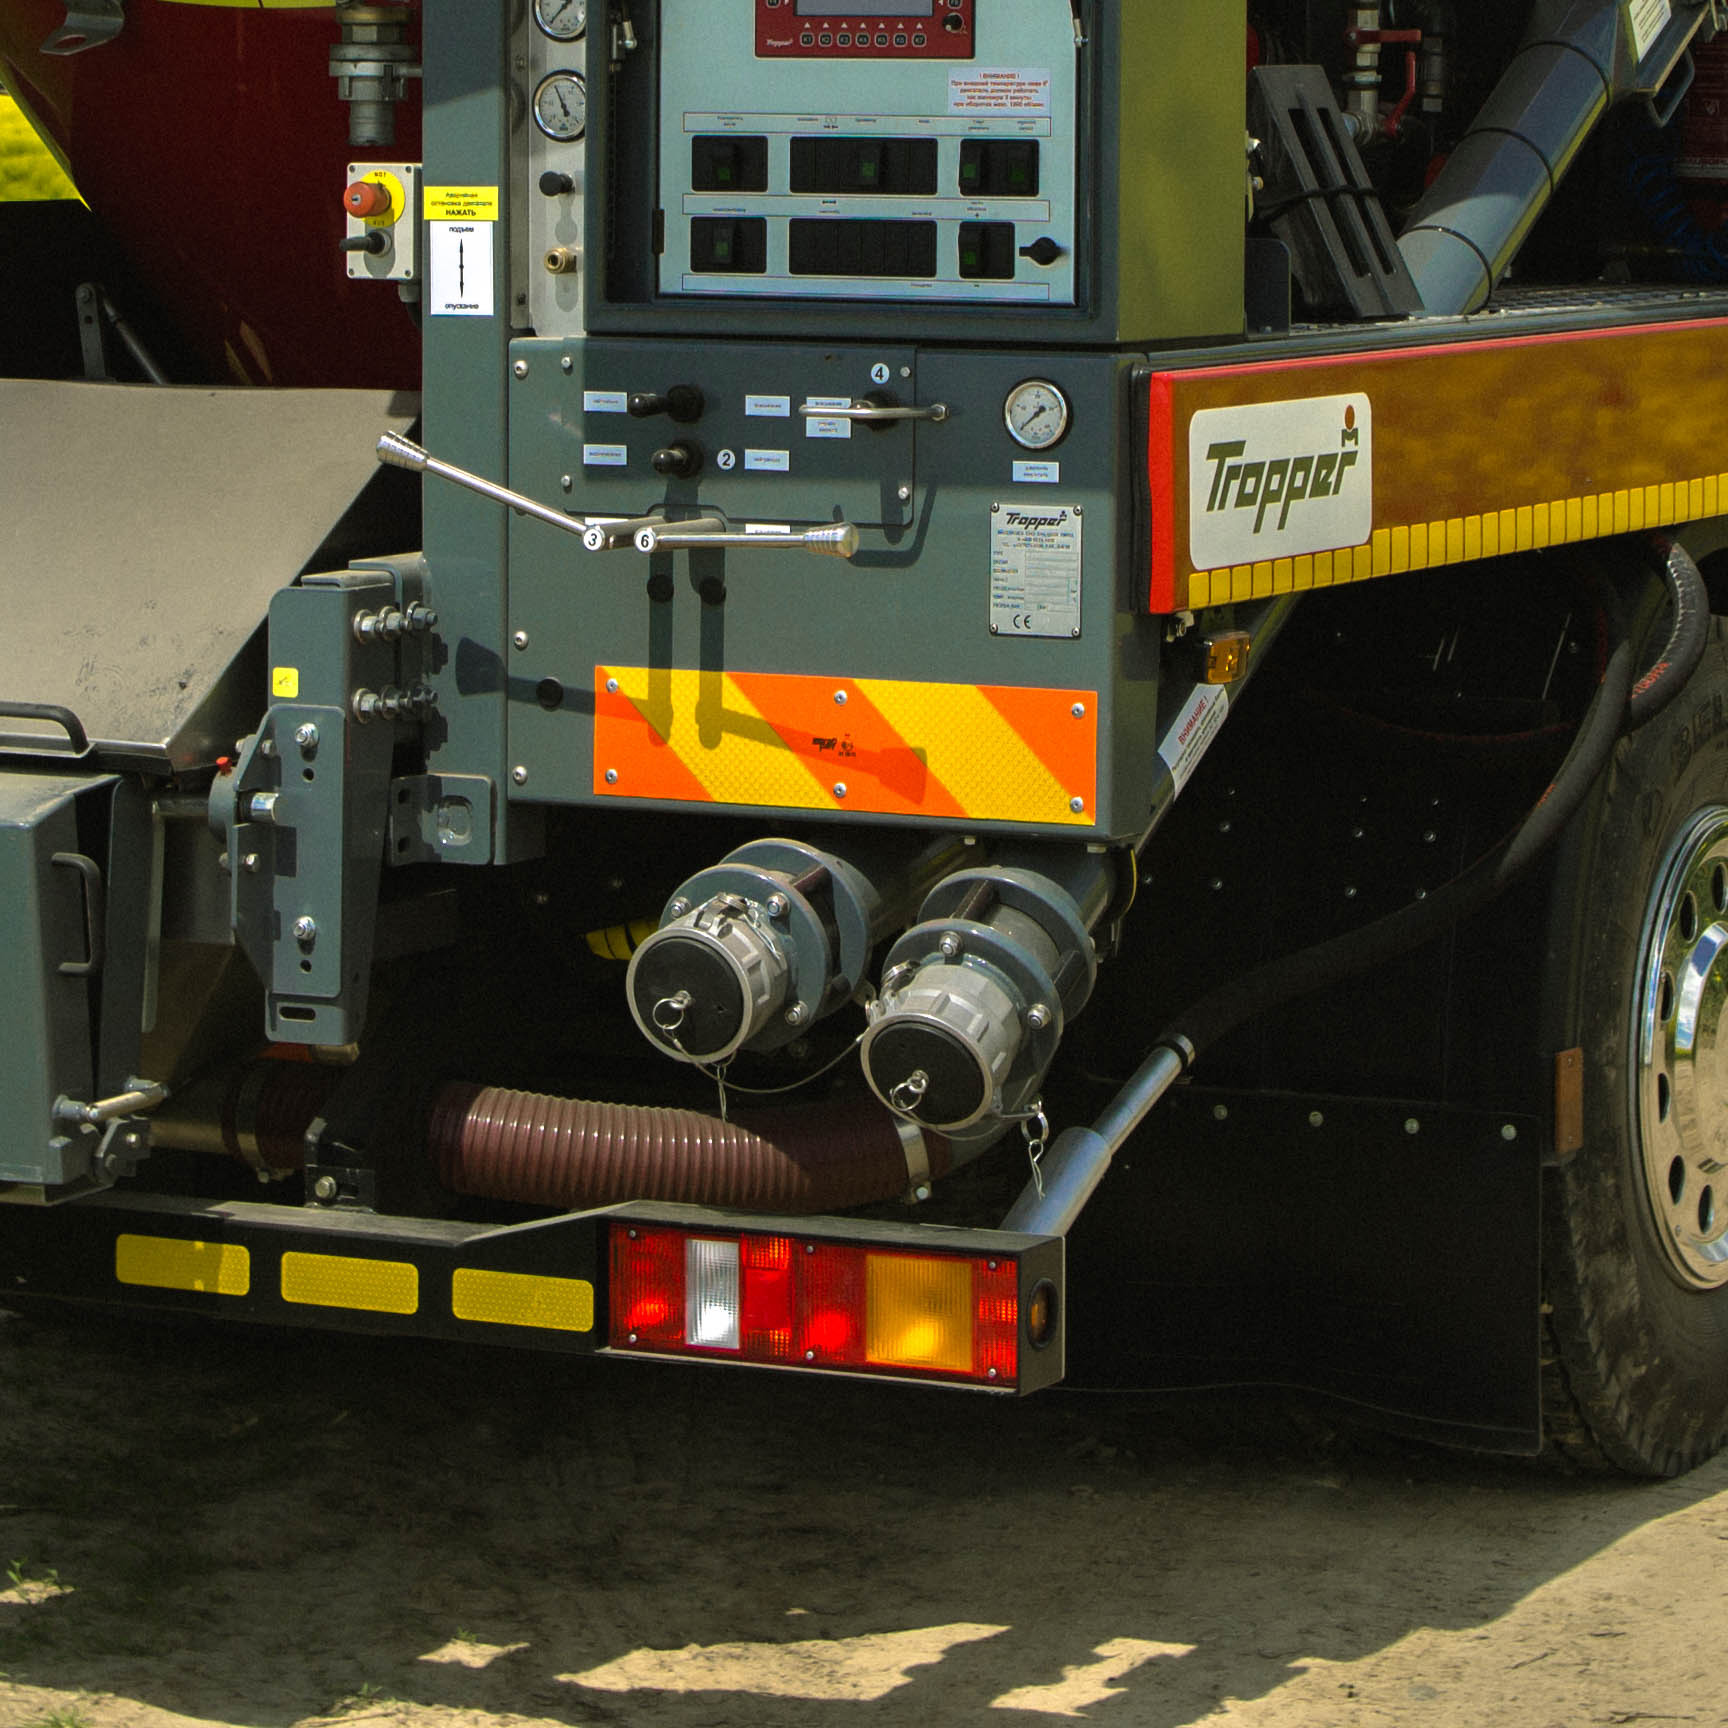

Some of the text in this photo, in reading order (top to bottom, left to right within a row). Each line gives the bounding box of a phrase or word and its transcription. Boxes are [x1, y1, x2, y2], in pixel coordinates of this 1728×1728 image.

[445, 209, 477, 217] НАЖАТЬ
[874, 367, 883, 380] 4
[722, 452, 731, 467] 2
[1206, 440, 1358, 535] Tropper
[1006, 512, 1067, 530] Tropper
[587, 533, 597, 547] 3
[640, 534, 649, 548] 6
[1013, 614, 1031, 630] CE
